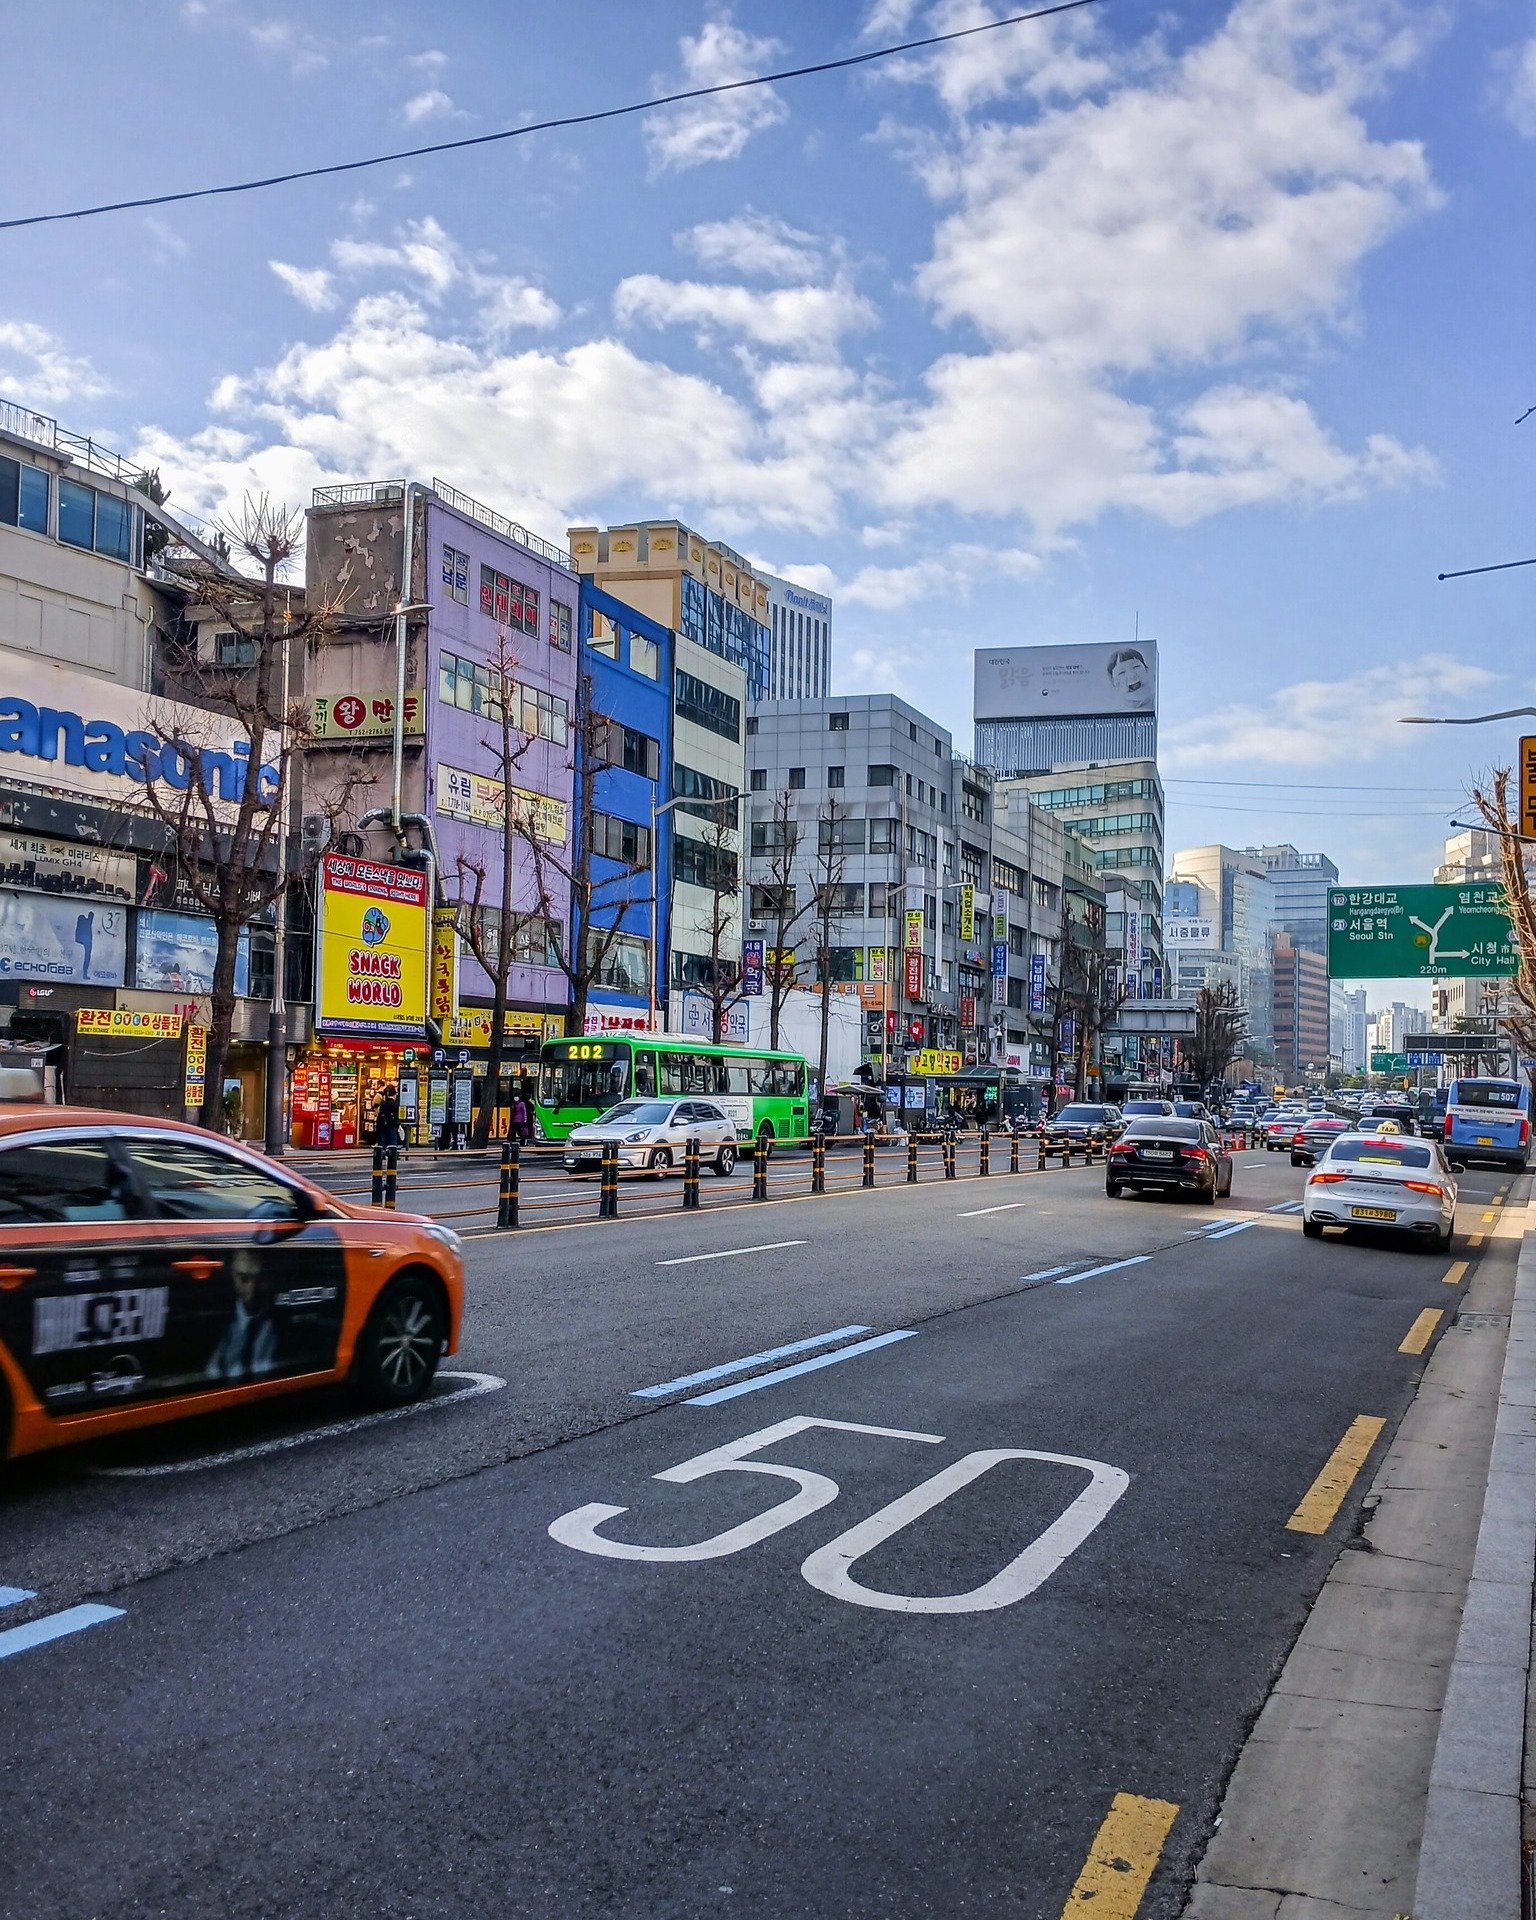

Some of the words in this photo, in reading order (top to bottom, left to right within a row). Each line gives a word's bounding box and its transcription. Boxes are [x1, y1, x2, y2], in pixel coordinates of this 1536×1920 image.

[339, 701, 359, 724] 왕
[448, 773, 471, 798] 유림
[10, 839, 27, 851] 세계
[30, 842, 47, 855] 최초
[1349, 893, 1398, 906] 한강대교
[1458, 891, 1498, 904] 염천교
[1349, 918, 1388, 930] 서울역
[1349, 932, 1374, 940] Seoul
[1377, 932, 1394, 940] Stn
[1470, 942, 1497, 955] 시청
[349, 949, 401, 979] SNACK
[1470, 956, 1491, 966] City
[1496, 956, 1515, 965] Hall
[1420, 965, 1447, 974] 220m
[348, 976, 402, 1007] WORLD
[79, 1009, 111, 1026] 환전
[152, 1016, 180, 1031] 상품권
[568, 1045, 602, 1060] 202
[1500, 1093, 1516, 1101] 507
[548, 1416, 1131, 1614] 50
